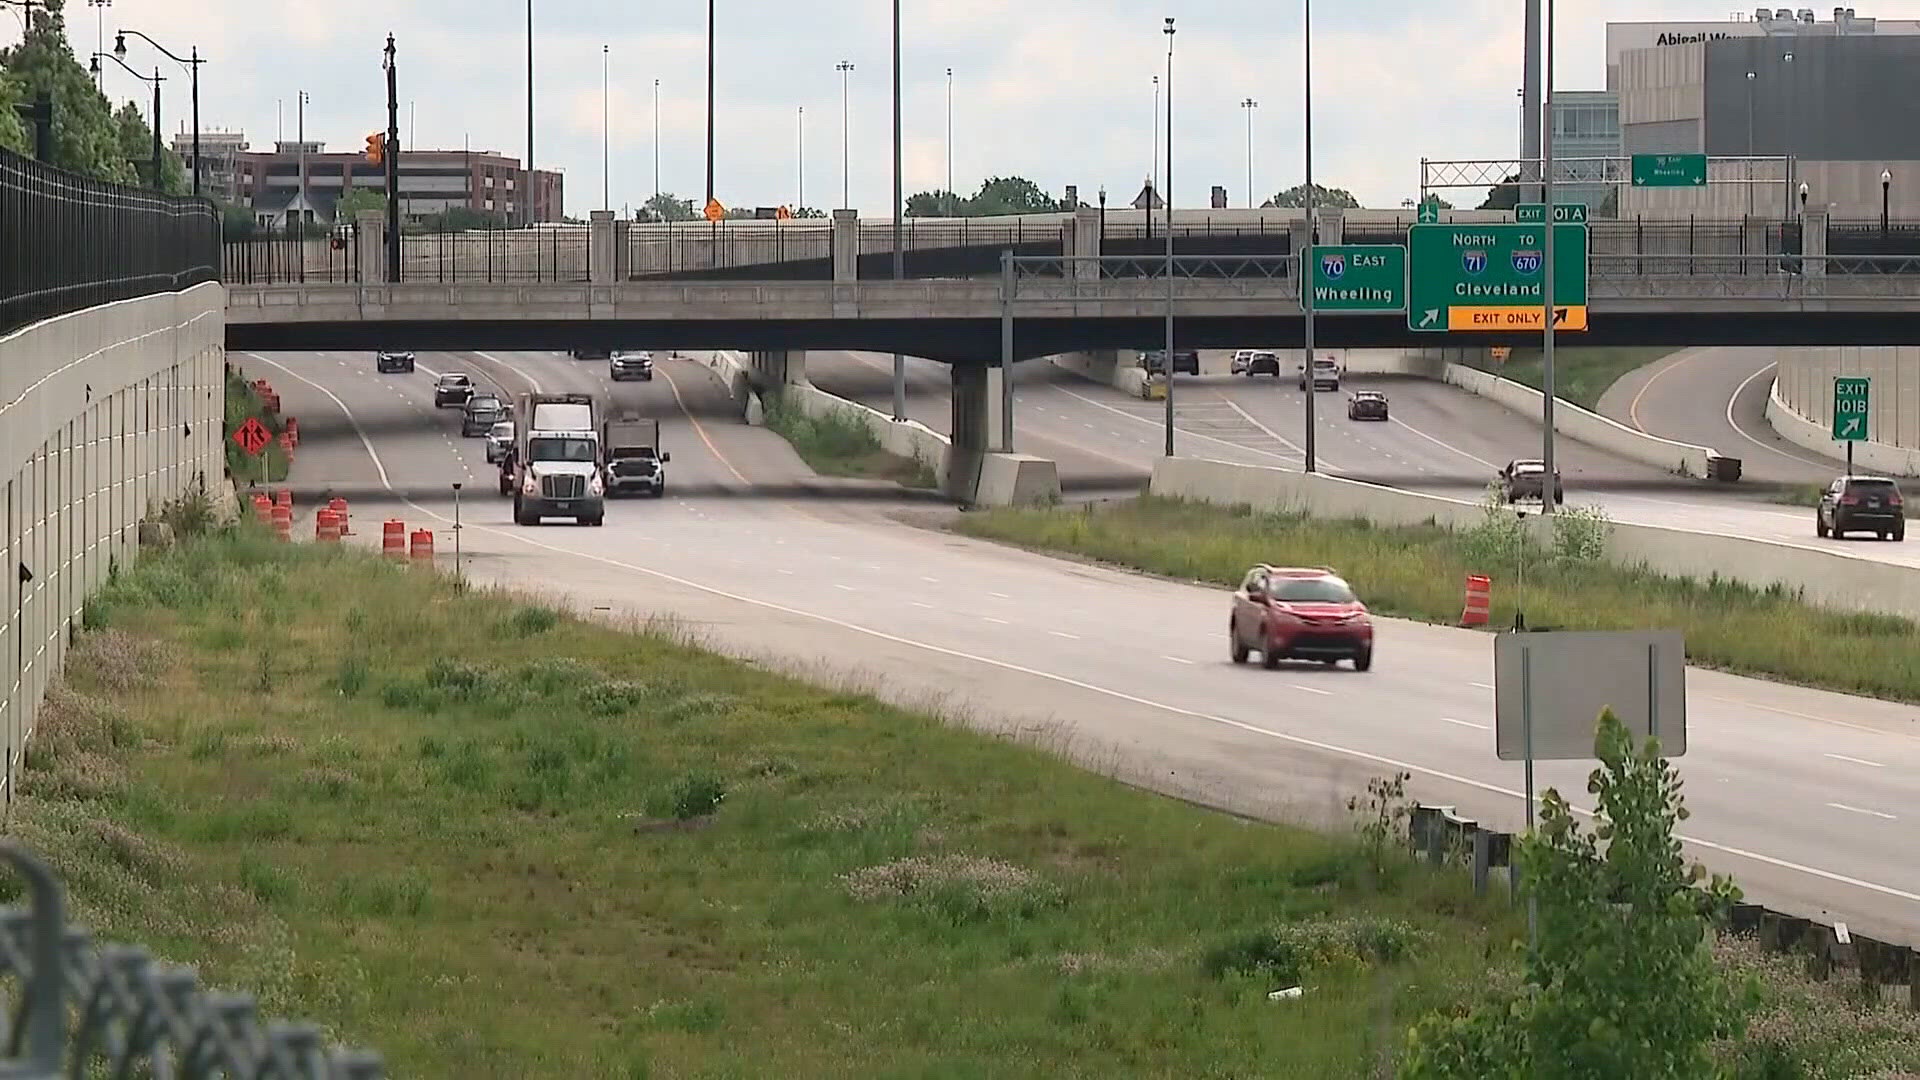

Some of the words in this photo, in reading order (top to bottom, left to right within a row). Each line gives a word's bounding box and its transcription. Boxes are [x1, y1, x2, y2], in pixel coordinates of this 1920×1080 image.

[1657, 32, 1705, 46] Abigail
[1518, 208, 1541, 219] EXIT
[1453, 233, 1496, 246] NORTH
[1519, 235, 1535, 245] TO
[1324, 261, 1343, 275] 70
[1353, 254, 1386, 266] EAST
[1466, 256, 1480, 271] 71
[1516, 257, 1537, 270] 670
[1315, 287, 1392, 303] Wheeling
[1455, 283, 1540, 296] Cleveland
[1473, 313, 1500, 323] EXIT
[1507, 313, 1541, 323] ONLY
[1837, 383, 1867, 395] EXIT
[1836, 399, 1866, 413] 101B
